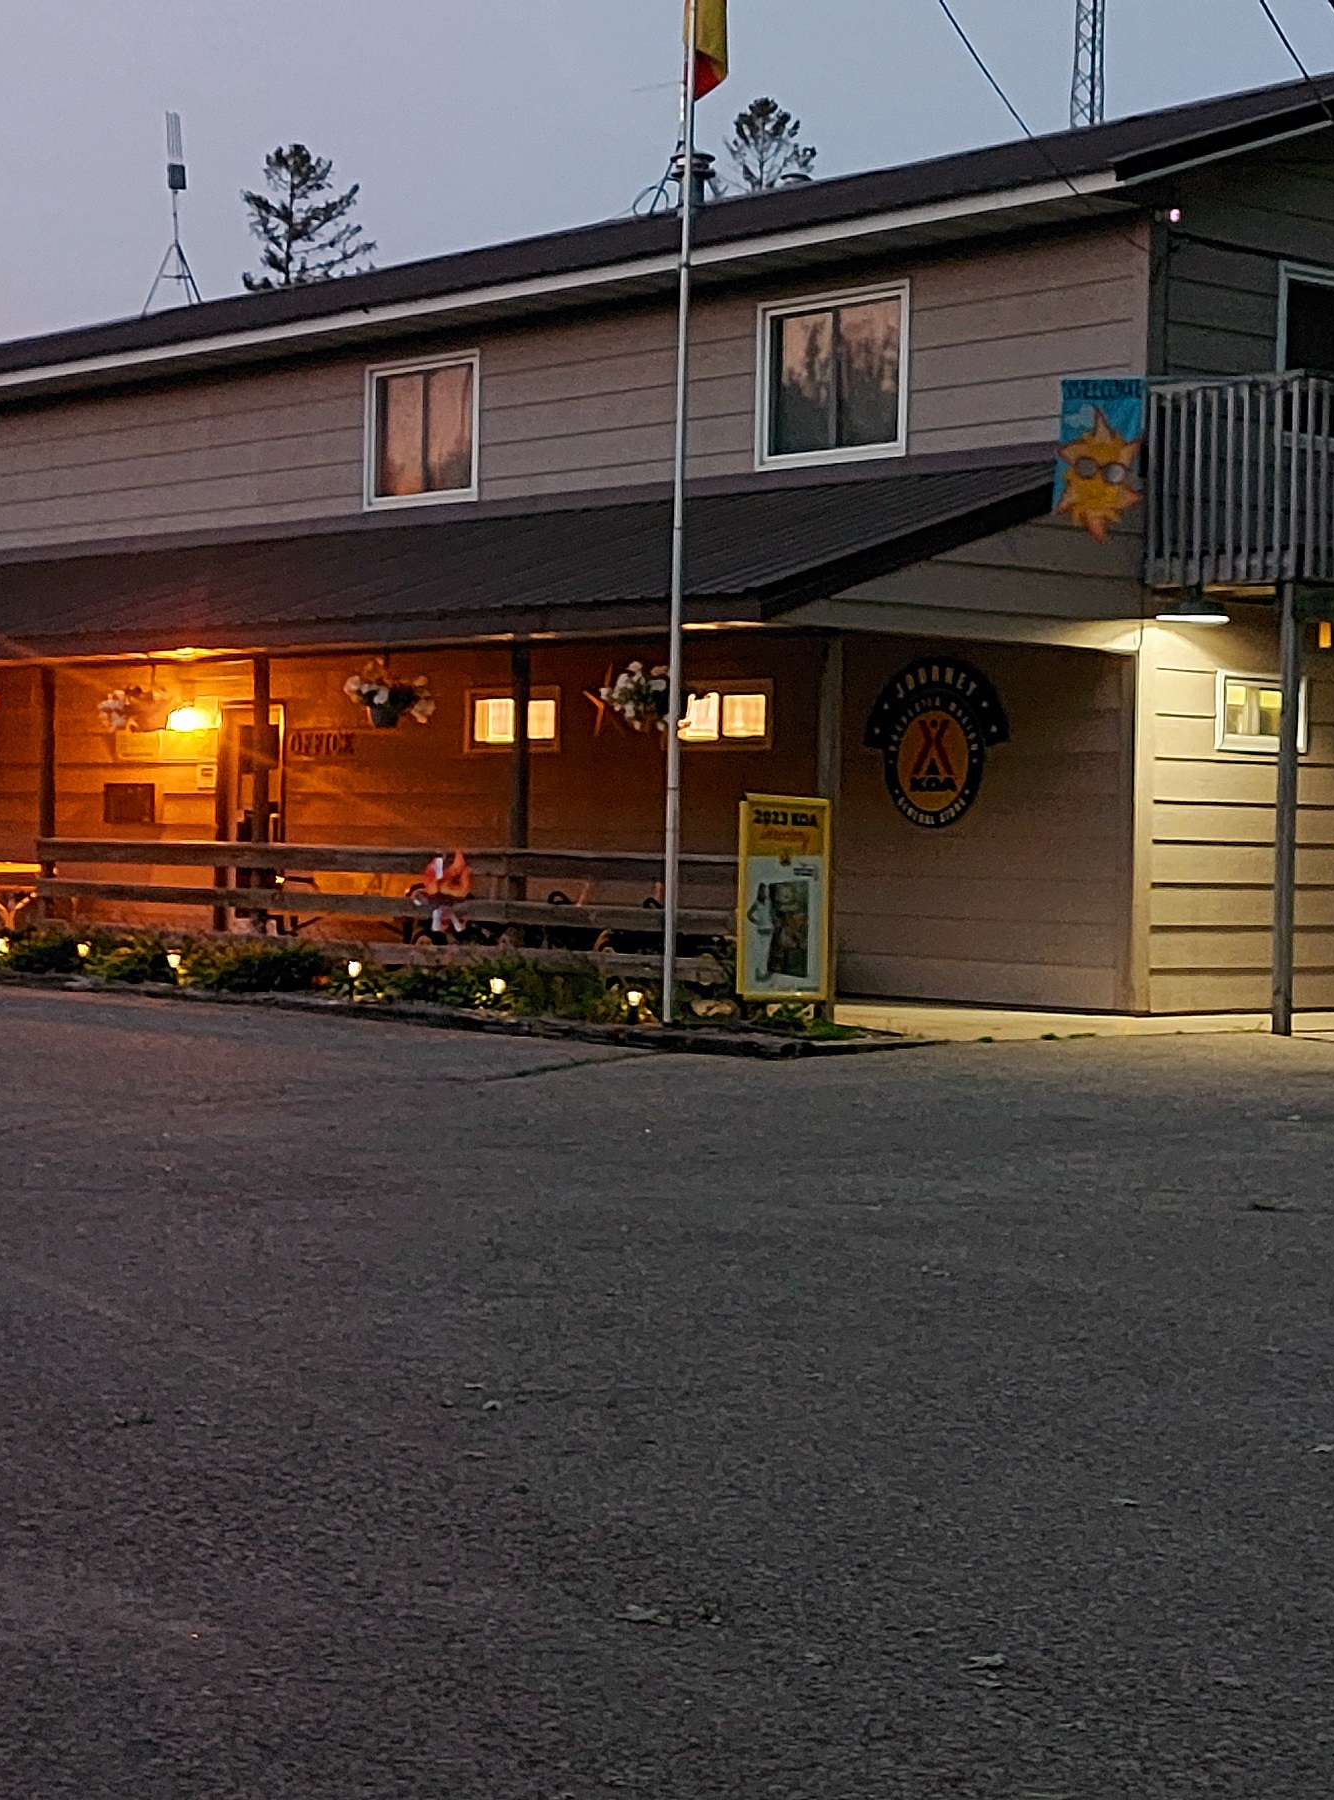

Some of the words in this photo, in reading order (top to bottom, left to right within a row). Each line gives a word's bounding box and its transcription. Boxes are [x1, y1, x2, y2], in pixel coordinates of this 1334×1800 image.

[895, 664, 979, 699] JOURNEY
[288, 732, 355, 756] OFFICE
[910, 777, 957, 792] KOA
[753, 809, 788, 826] 2023
[791, 812, 818, 828] KOA
